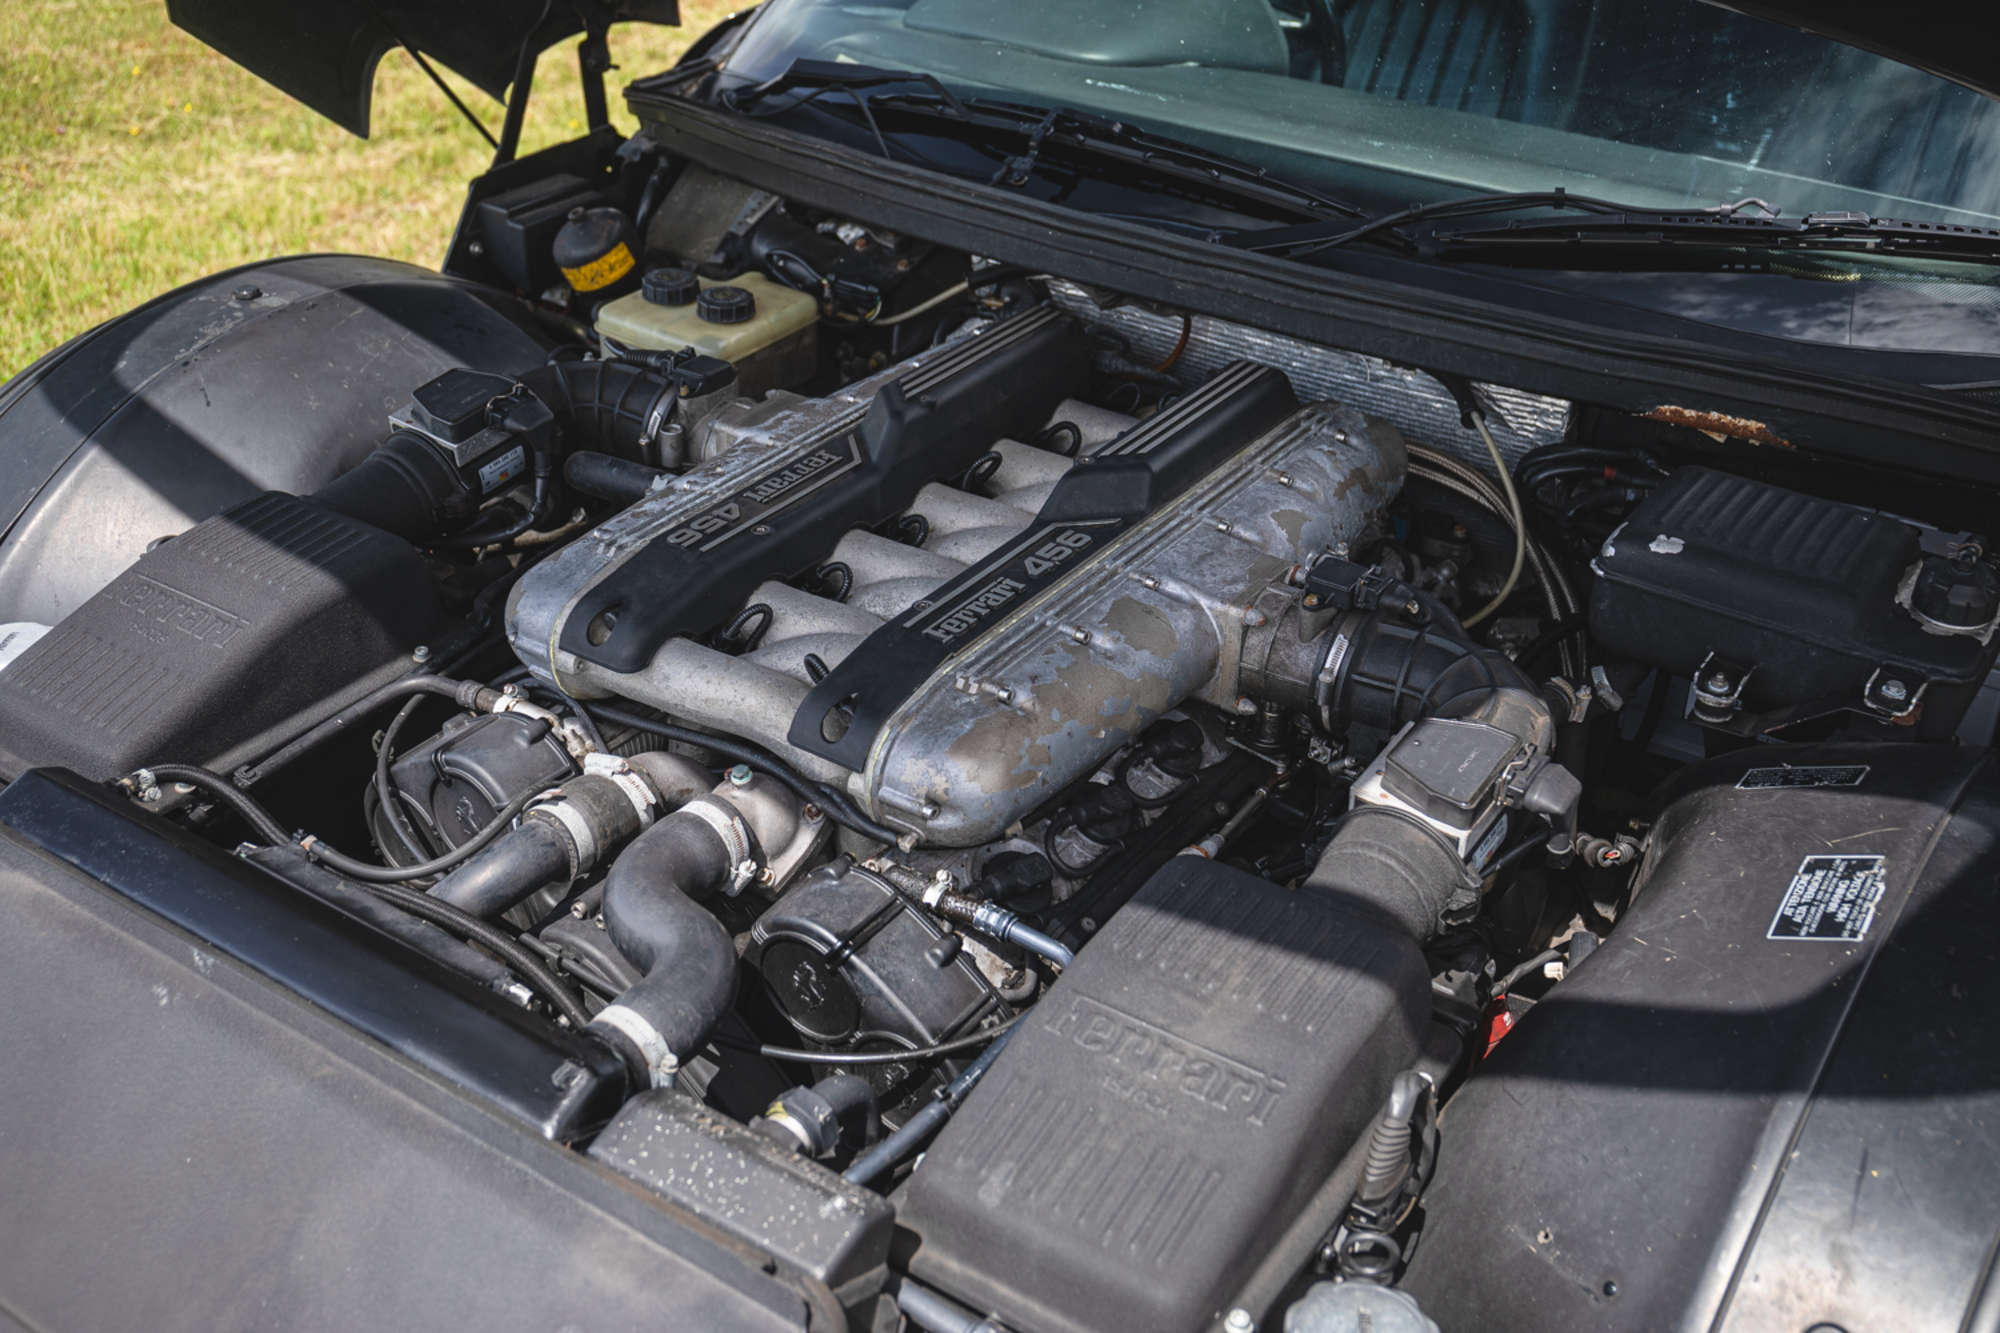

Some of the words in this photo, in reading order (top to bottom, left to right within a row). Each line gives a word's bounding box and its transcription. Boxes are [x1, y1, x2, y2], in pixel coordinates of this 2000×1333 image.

[743, 449, 844, 504] Ferrari
[666, 502, 741, 547] 456
[103, 572, 250, 649] Ferrari
[922, 576, 1027, 644] Ferrari
[1023, 529, 1094, 577] 456
[1044, 990, 1288, 1126] Ferrari
